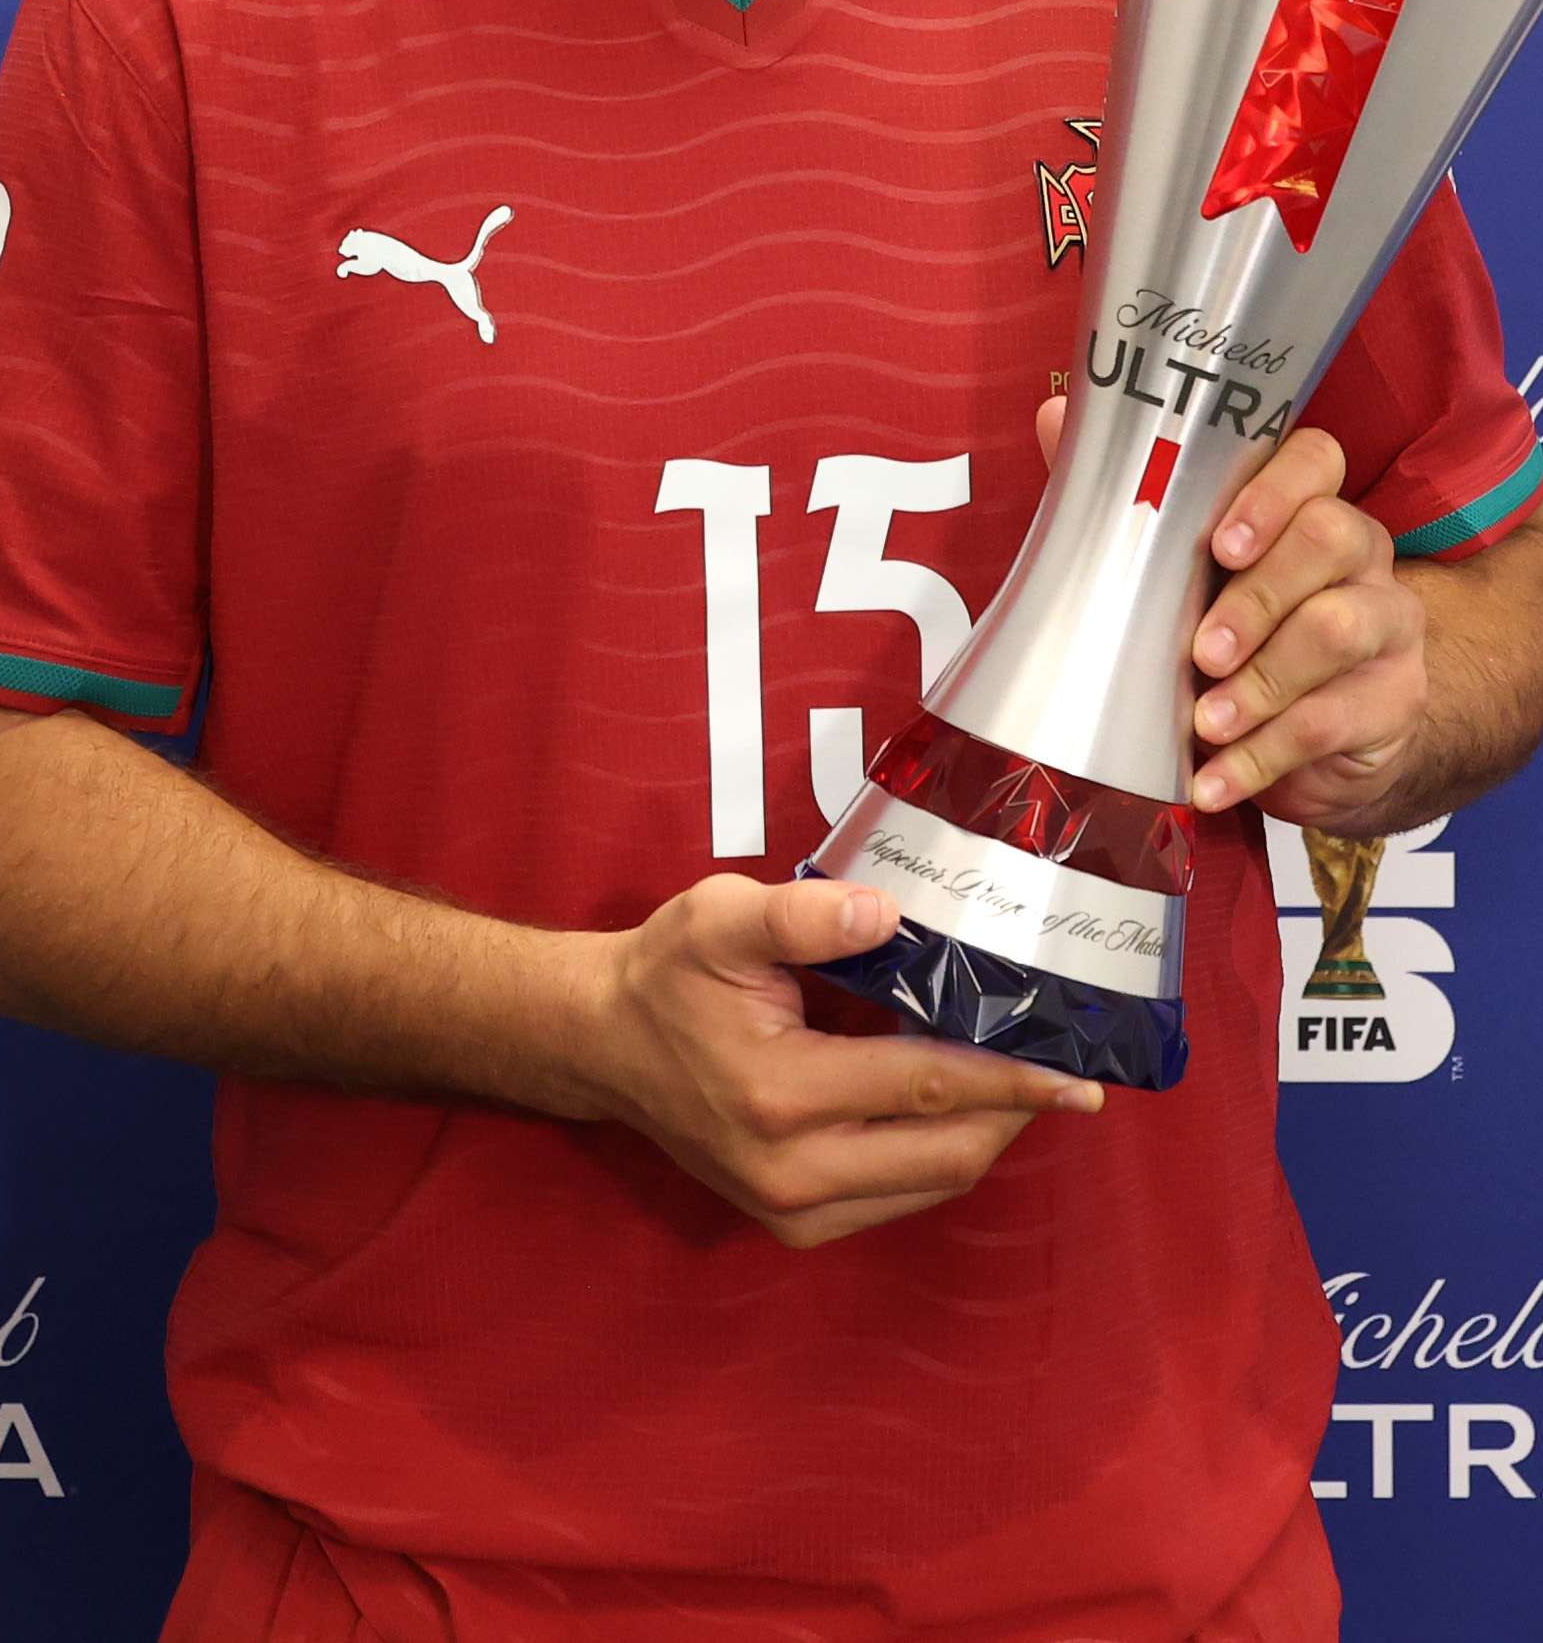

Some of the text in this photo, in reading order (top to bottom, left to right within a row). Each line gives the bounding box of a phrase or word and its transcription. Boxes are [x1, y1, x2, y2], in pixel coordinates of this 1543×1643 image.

[1115, 288, 1297, 375] Michelob
[1086, 329, 1294, 445] ULTRA
[653, 452, 974, 859] 15
[860, 828, 946, 884] Superior
[1296, 1014, 1398, 1053] FIFA
